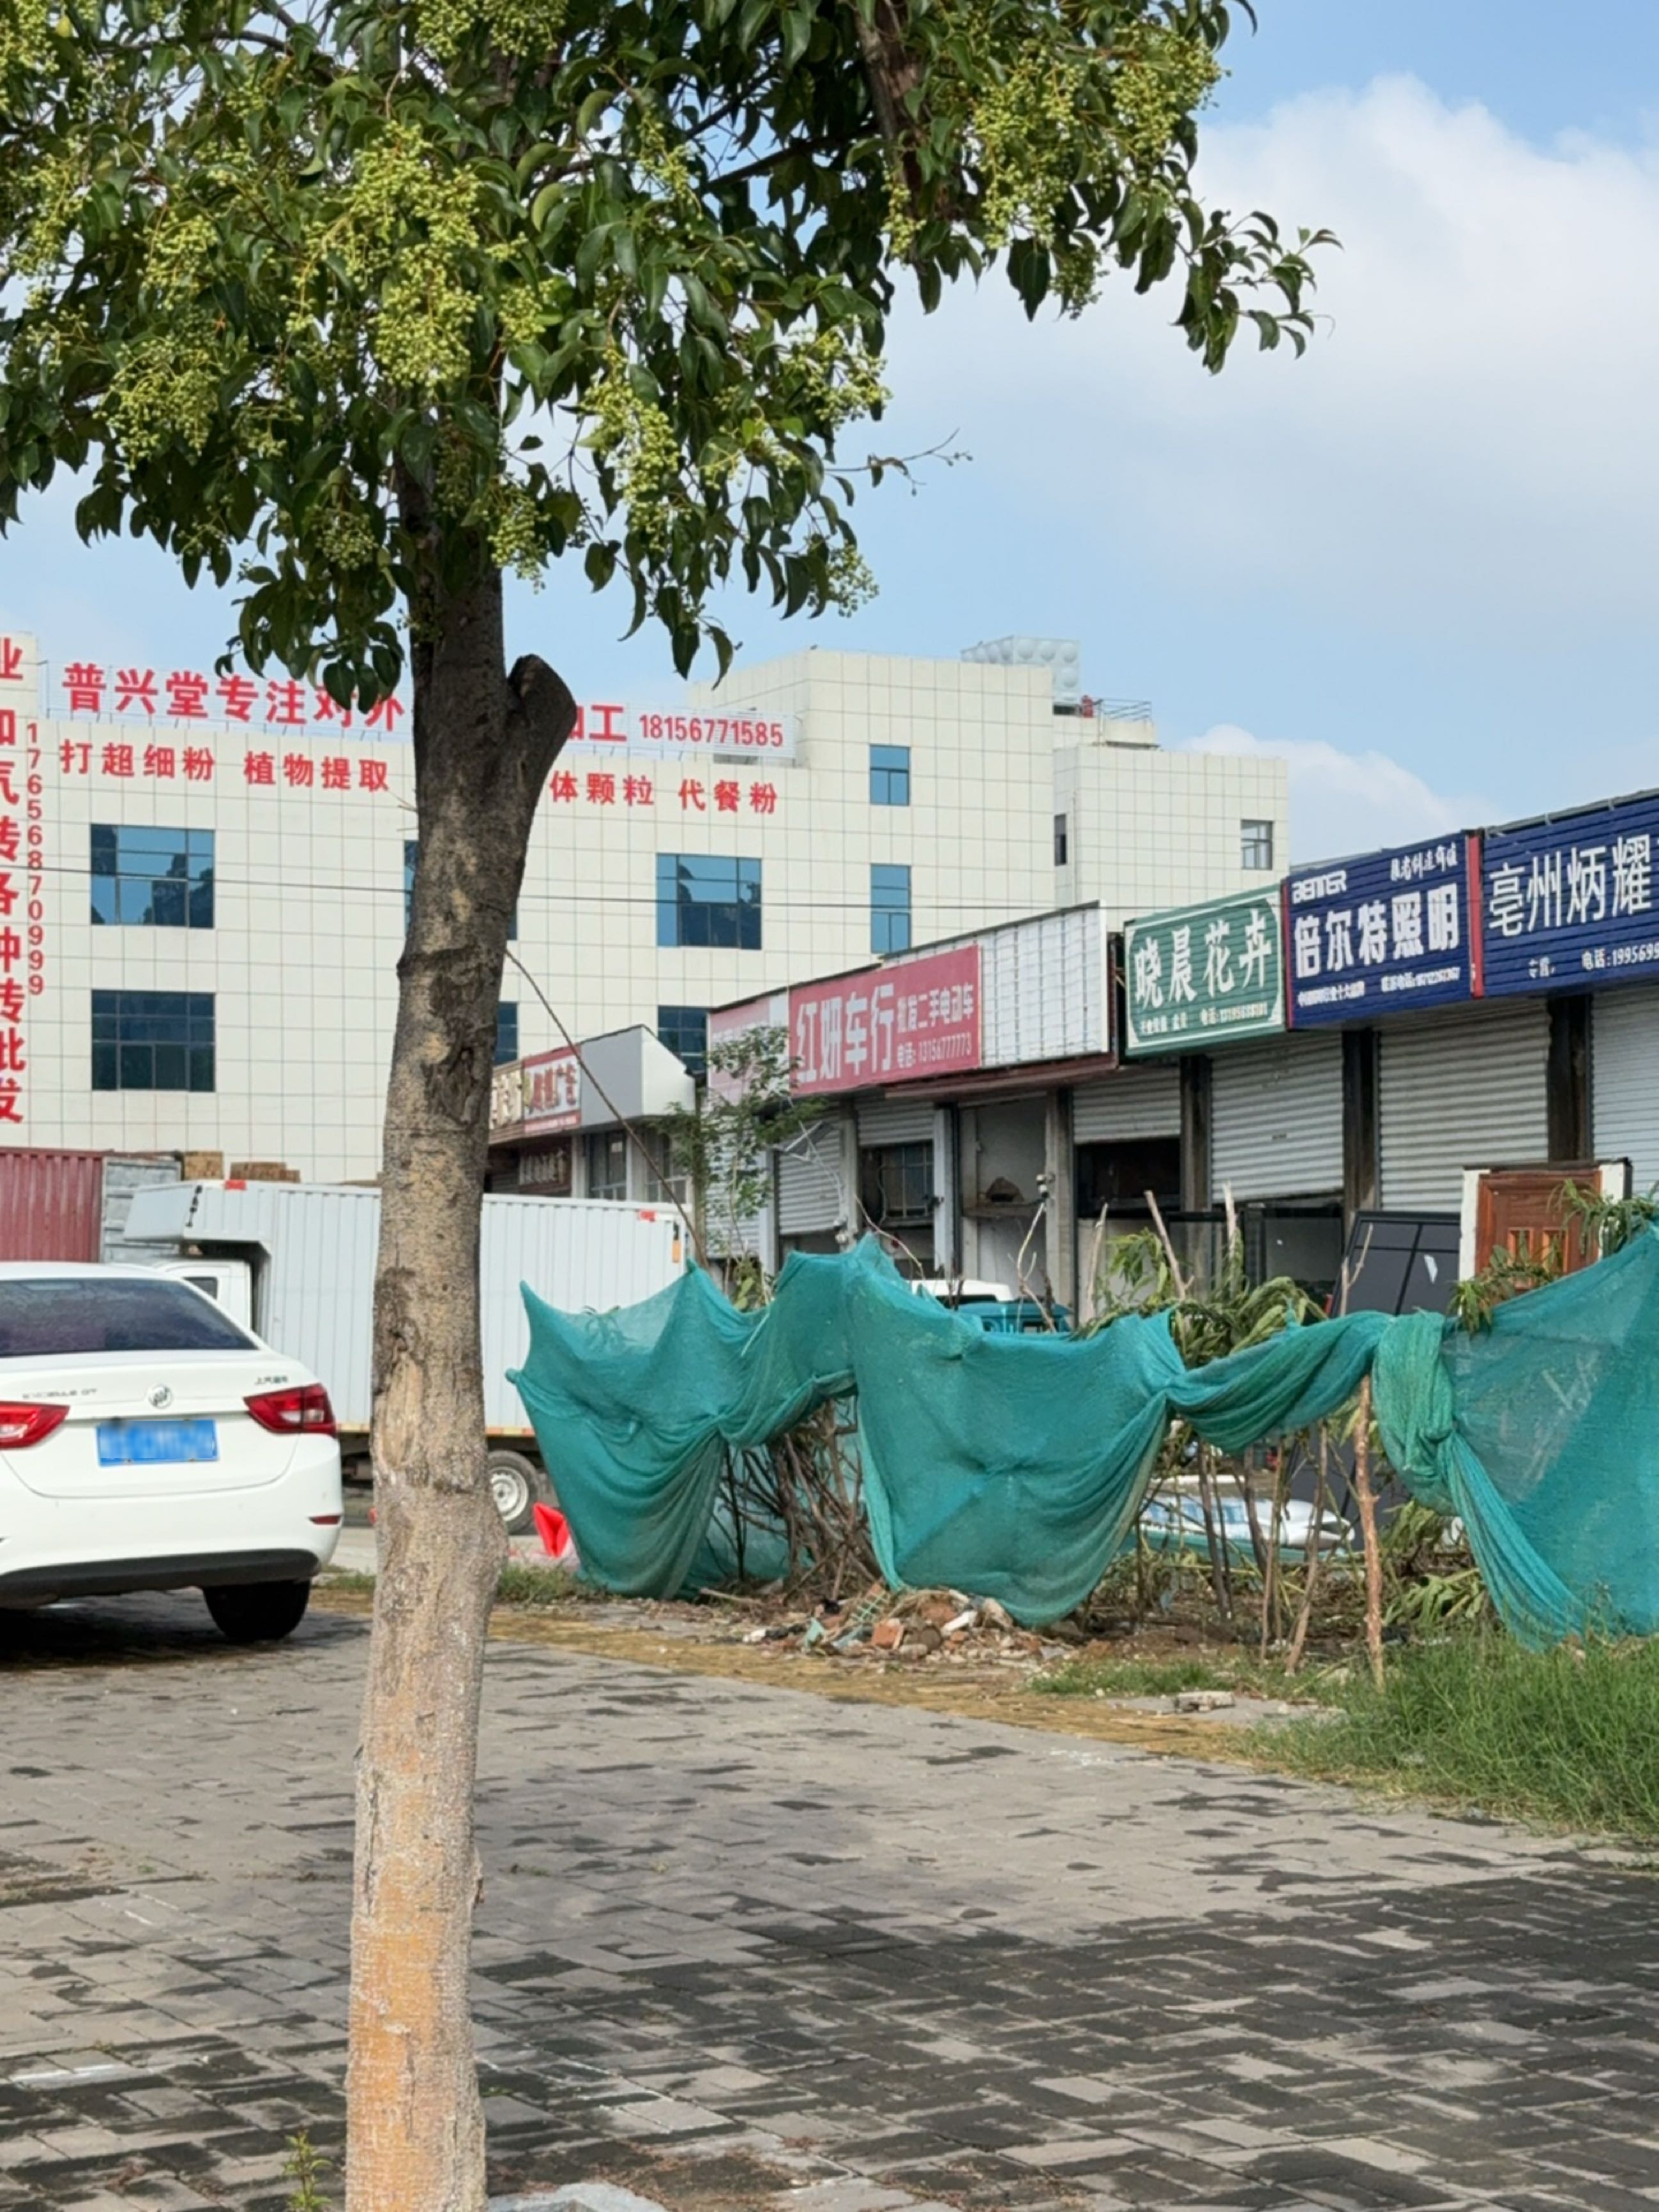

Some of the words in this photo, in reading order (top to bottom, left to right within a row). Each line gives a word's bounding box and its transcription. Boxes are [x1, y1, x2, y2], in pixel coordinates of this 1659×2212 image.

[59, 738, 215, 781] 打超细粉
[244, 750, 389, 793] 植物提取
[678, 778, 777, 814] 代餐粉
[639, 714, 783, 748] 18156771585
[27, 723, 43, 996] 17656870999
[1134, 908, 1272, 1010] 晓晨花卉
[1294, 883, 1460, 979] 倍尔特照明
